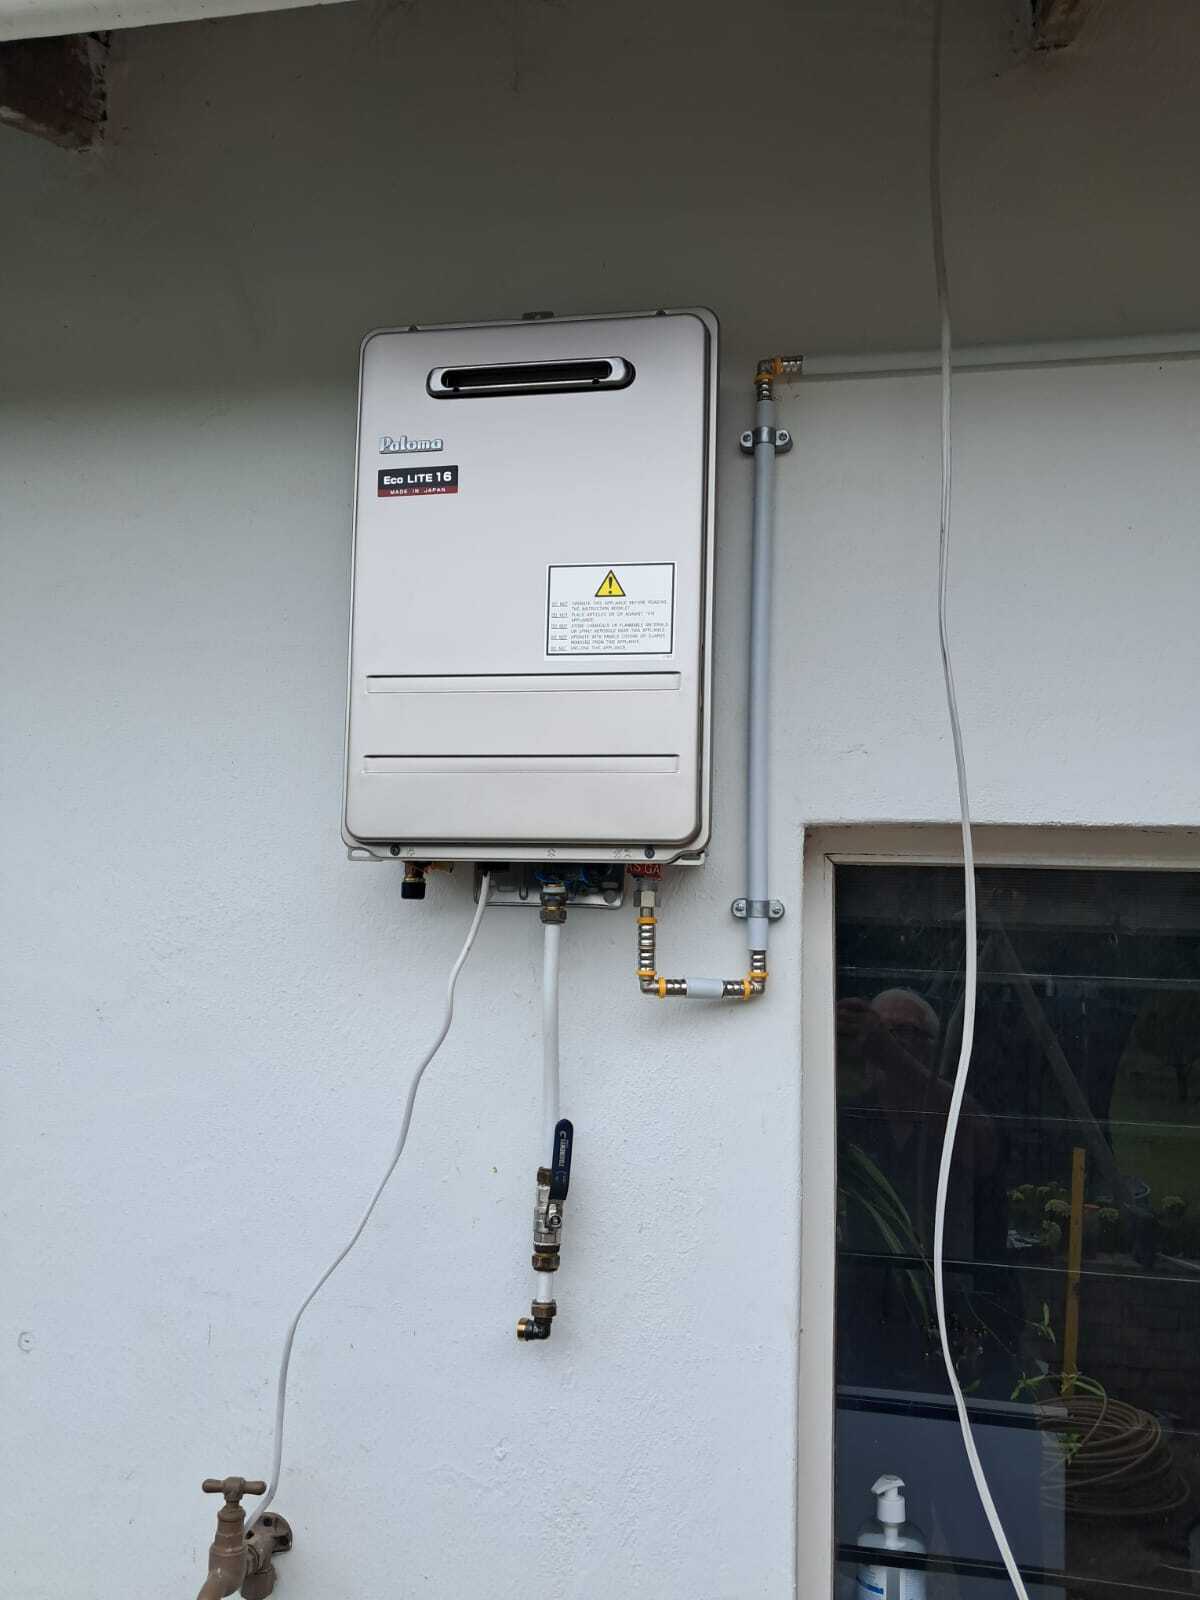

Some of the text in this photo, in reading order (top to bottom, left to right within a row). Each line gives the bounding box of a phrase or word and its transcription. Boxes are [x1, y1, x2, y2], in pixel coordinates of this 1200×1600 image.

[379, 435, 443, 454] Paloma
[383, 471, 452, 485] Eco LITE 16
[423, 486, 446, 494] JAPAN
